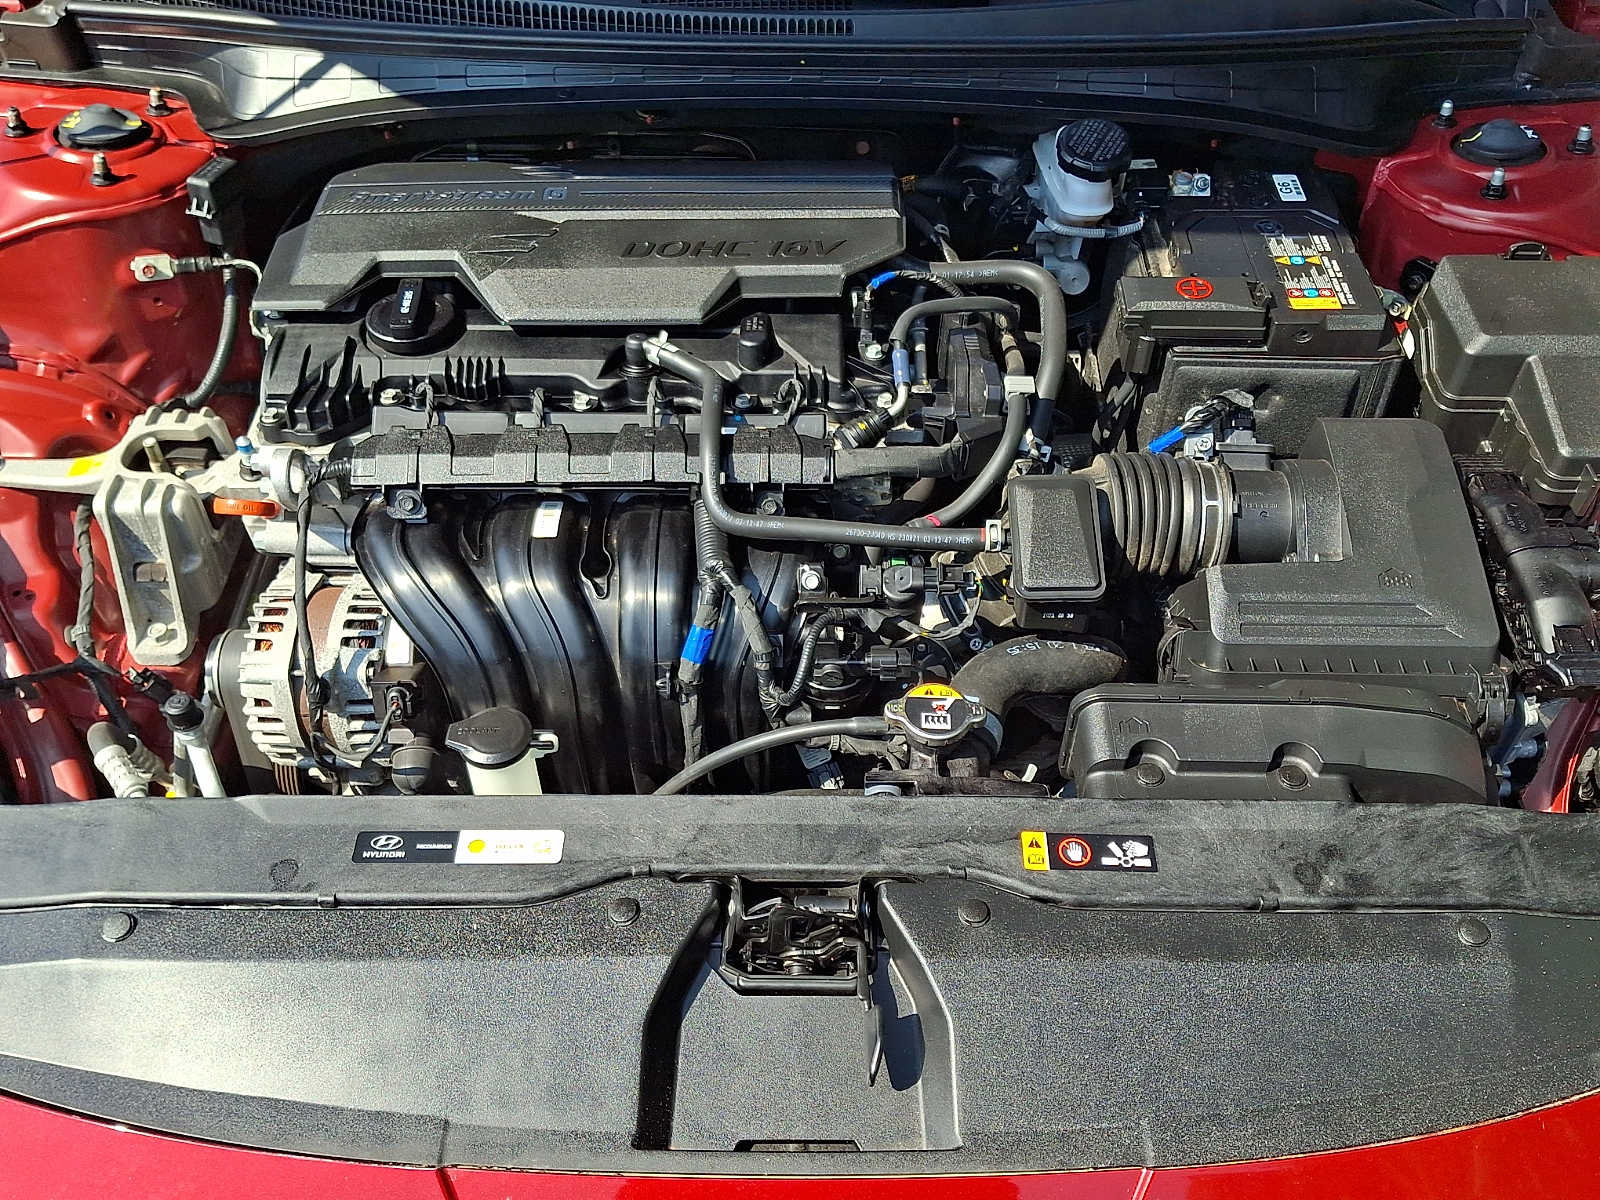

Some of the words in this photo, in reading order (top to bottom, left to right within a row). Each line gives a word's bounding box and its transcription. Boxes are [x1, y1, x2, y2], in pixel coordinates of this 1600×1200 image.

[1278, 182, 1293, 193] G6
[619, 239, 757, 258] DOHC
[766, 239, 848, 257] 16V
[362, 850, 406, 859] HYUNDAI
